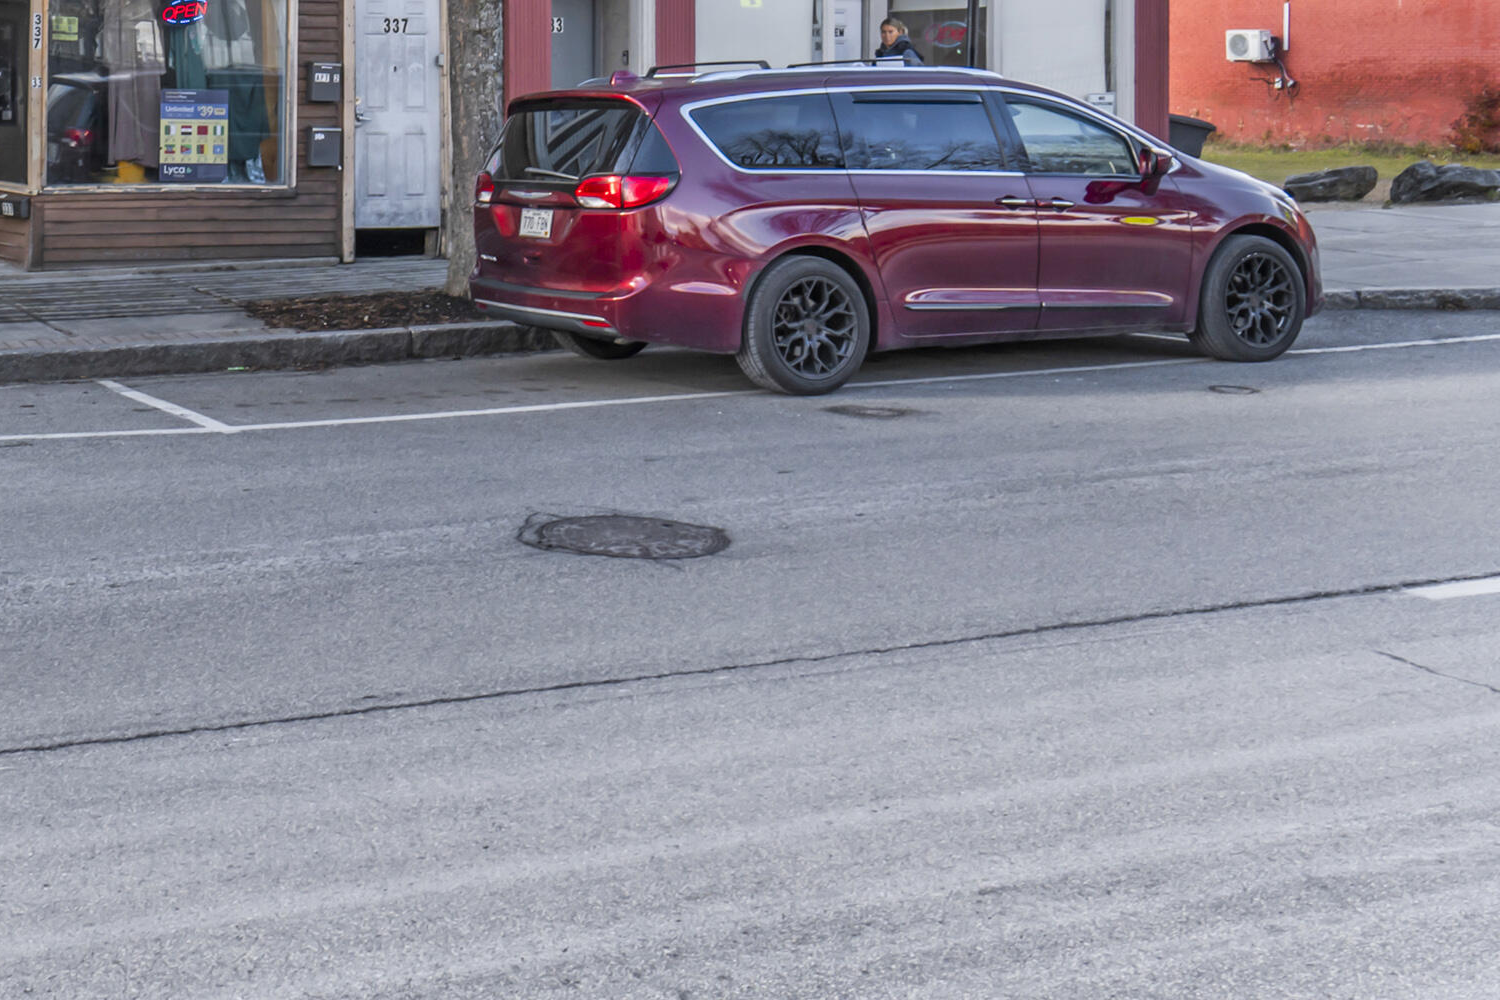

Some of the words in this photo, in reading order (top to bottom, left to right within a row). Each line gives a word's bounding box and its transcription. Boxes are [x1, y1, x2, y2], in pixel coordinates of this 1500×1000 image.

[162, 1, 208, 21] OPEN
[34, 14, 42, 49] 337
[383, 18, 409, 34] 337
[163, 165, 185, 176] Lyca
